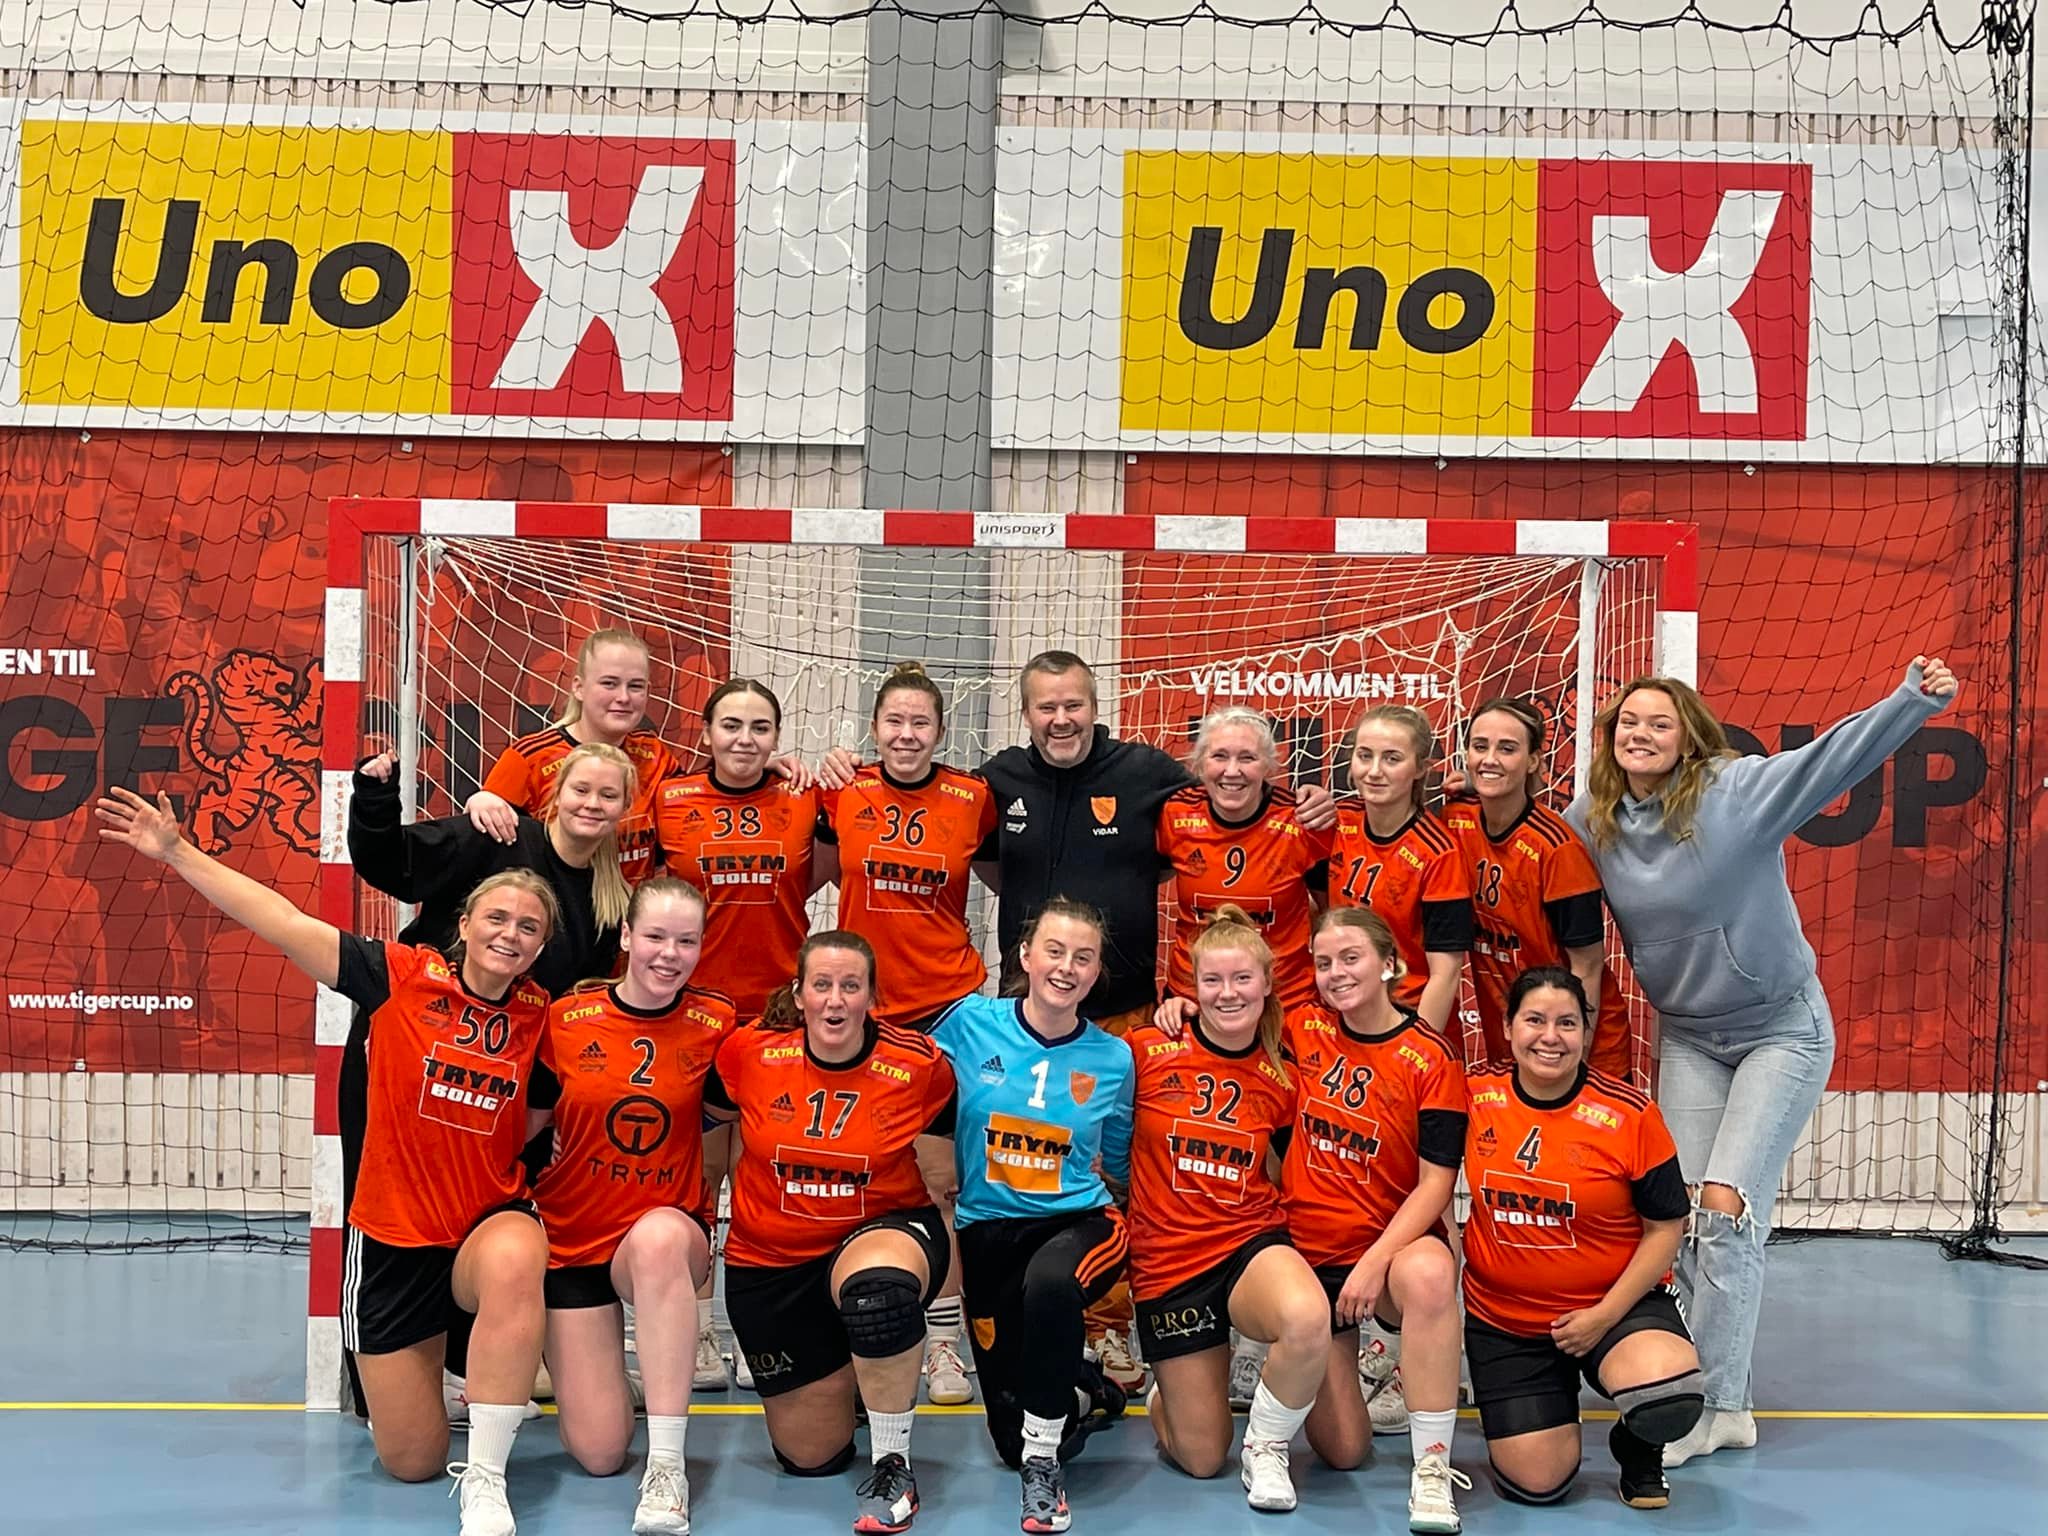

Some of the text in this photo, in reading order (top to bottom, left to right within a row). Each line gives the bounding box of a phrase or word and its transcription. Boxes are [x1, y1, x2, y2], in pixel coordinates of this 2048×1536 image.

[79, 198, 411, 329] Uno
[1178, 227, 1495, 354] Uno
[48, 649, 96, 676] TIL
[1190, 671, 1448, 699] VELKOMMEN TIL
[664, 787, 702, 799] EXTRA
[940, 783, 975, 801] EXTRA
[712, 806, 762, 839] 38
[879, 804, 928, 846] 36
[1174, 818, 1208, 828] EXTRA
[696, 855, 787, 873] TRYM
[863, 859, 948, 886] TRYM
[1223, 845, 1246, 887] 9
[711, 873, 773, 885] BOLIG
[874, 879, 932, 895] BOLIG
[1341, 856, 1384, 906] 11
[1475, 858, 1503, 908] 18
[8, 990, 194, 1016] www.tigercup.no
[563, 1005, 603, 1022] EXTRA
[454, 1004, 511, 1056] 50
[687, 1008, 723, 1031] EXTRA
[629, 1036, 656, 1086] 2
[763, 1047, 803, 1058] EXTRA
[1148, 1041, 1189, 1056] EXTRA
[423, 1055, 519, 1099] TRYM
[871, 1061, 911, 1083] EXTRA
[1028, 1060, 1050, 1109] 1
[1320, 1054, 1374, 1109] 48
[431, 1082, 499, 1110] BOLIG
[1190, 1072, 1242, 1125] 32
[804, 1088, 860, 1139] 17
[1577, 1103, 1618, 1128] EXTRA
[984, 1127, 1072, 1157] TRYM
[1301, 1111, 1381, 1157] TRYM
[993, 1152, 1056, 1170] BOLIG
[1167, 1133, 1256, 1169] TRYM
[1514, 1125, 1542, 1172] 4
[587, 1157, 675, 1185] TRYM
[770, 1160, 872, 1187] TRYM
[1178, 1157, 1240, 1182] BOLIG
[786, 1181, 855, 1197] BOLIG
[1480, 1185, 1576, 1219] TRYM
[750, 1351, 793, 1371] ROA
